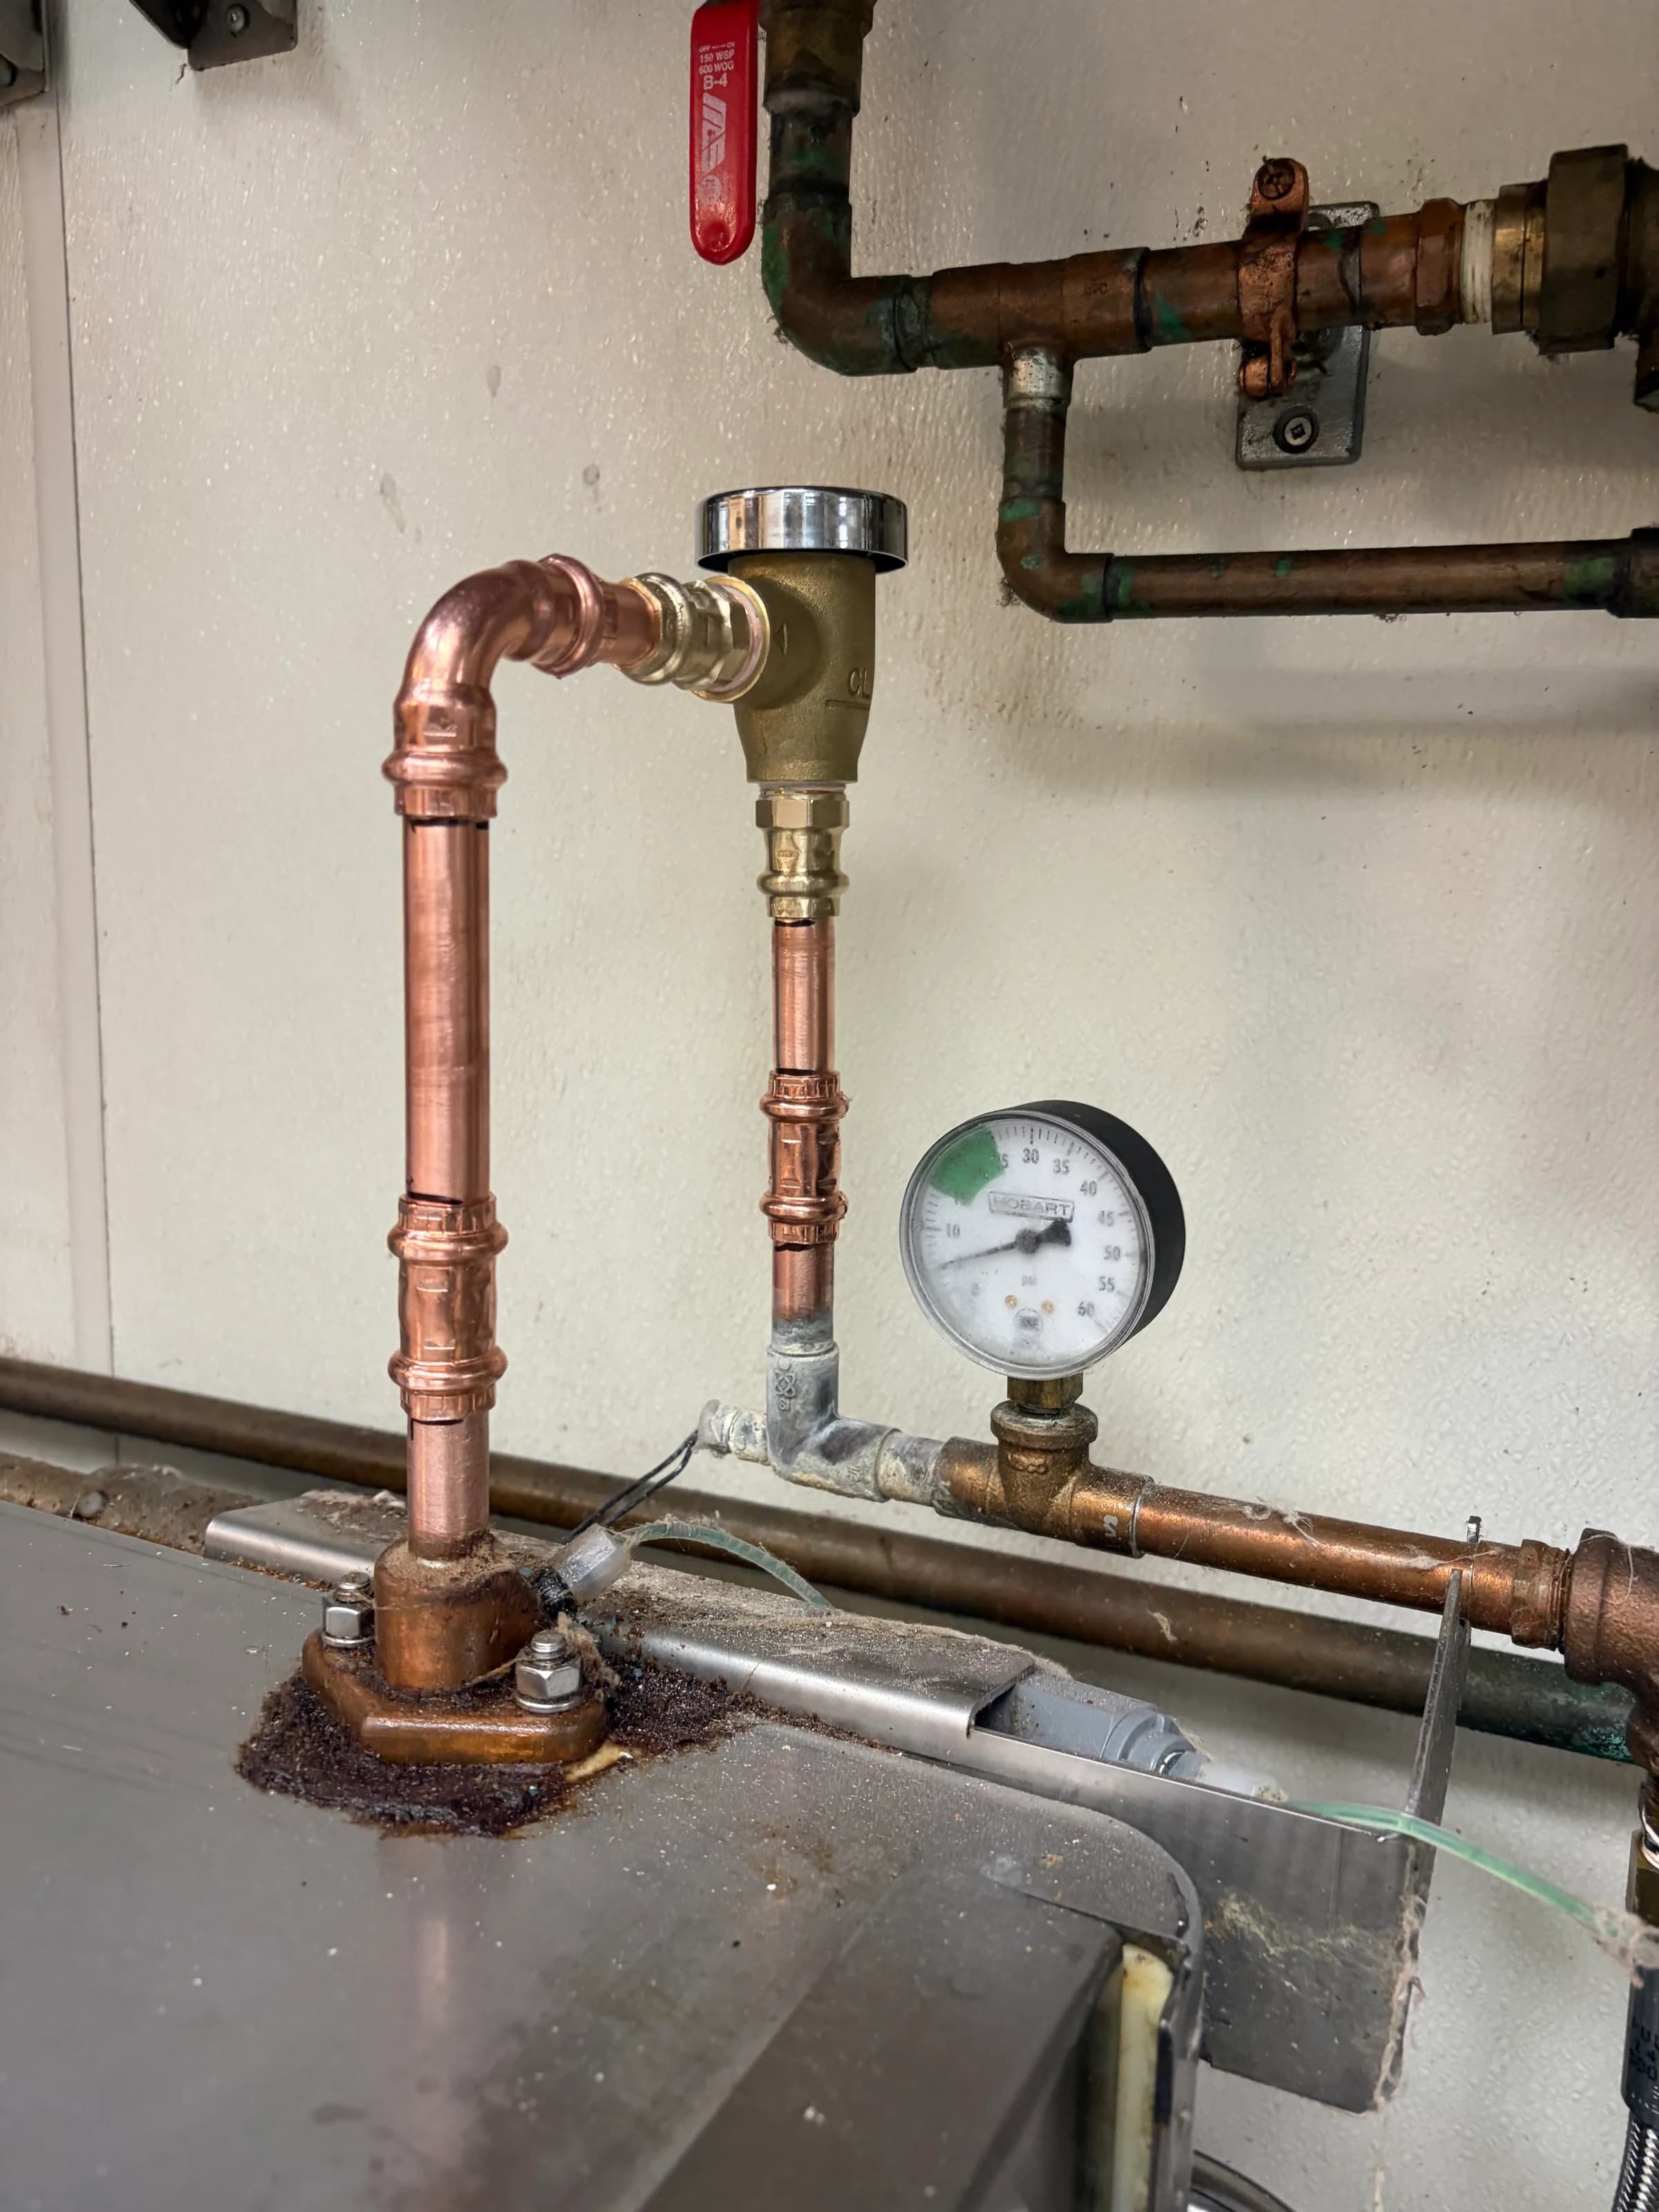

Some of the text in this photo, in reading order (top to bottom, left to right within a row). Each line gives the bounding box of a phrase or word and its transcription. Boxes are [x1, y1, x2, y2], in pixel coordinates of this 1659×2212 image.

[700, 48, 735, 64] 150 WSP
[699, 60, 735, 75] 600 WOG
[703, 71, 728, 90] B-4
[1022, 1147, 1040, 1165] 30
[1052, 1158, 1070, 1174] 35
[1080, 1180, 1098, 1197] 40
[992, 1195, 1071, 1217] HOBART
[1098, 1210, 1114, 1228] 45
[946, 1223, 960, 1238] 10
[1103, 1245, 1121, 1262] 50
[1098, 1275, 1116, 1293] 55
[1077, 1301, 1095, 1317] 60
